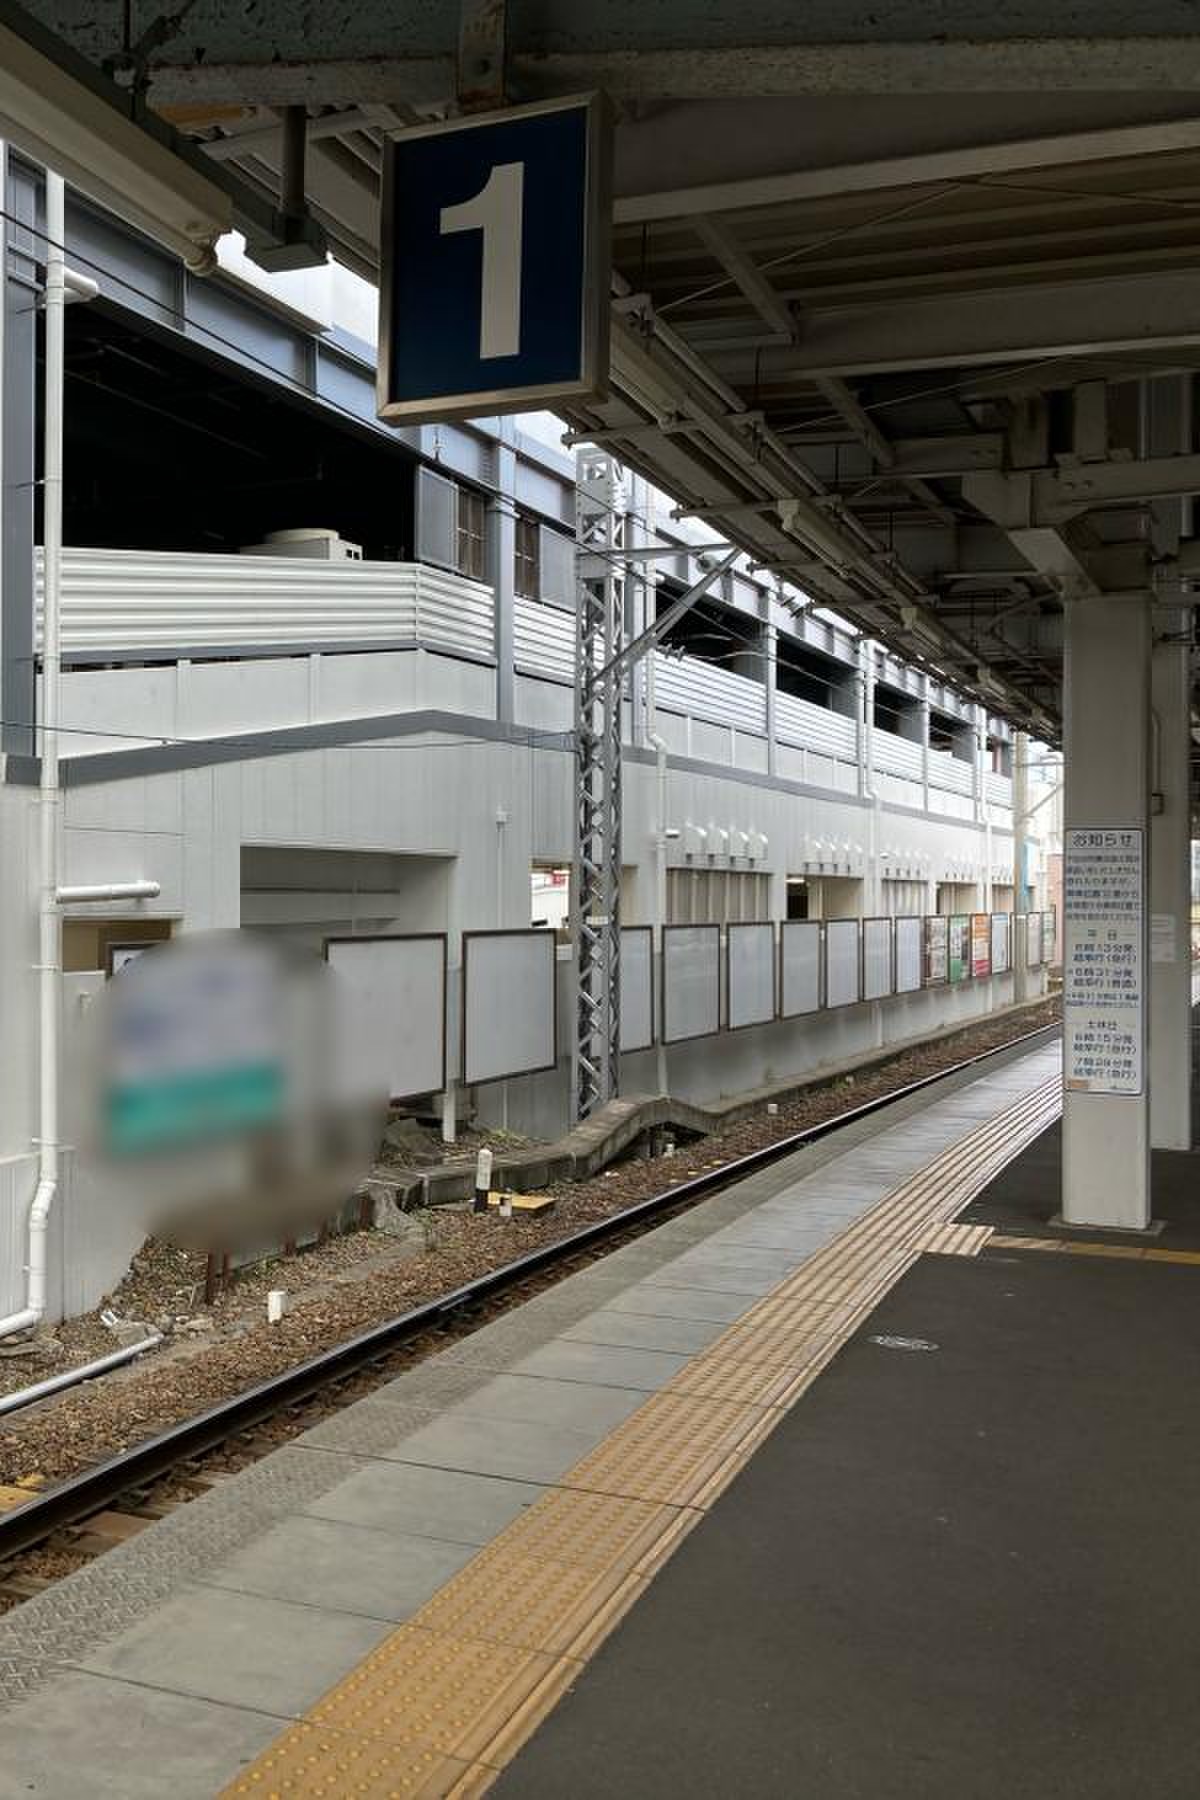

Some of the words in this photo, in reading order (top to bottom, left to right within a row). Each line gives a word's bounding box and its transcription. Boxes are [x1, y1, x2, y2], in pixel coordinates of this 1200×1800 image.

[440, 161, 525, 359] 1
[1072, 833, 1133, 848] お知らせ
